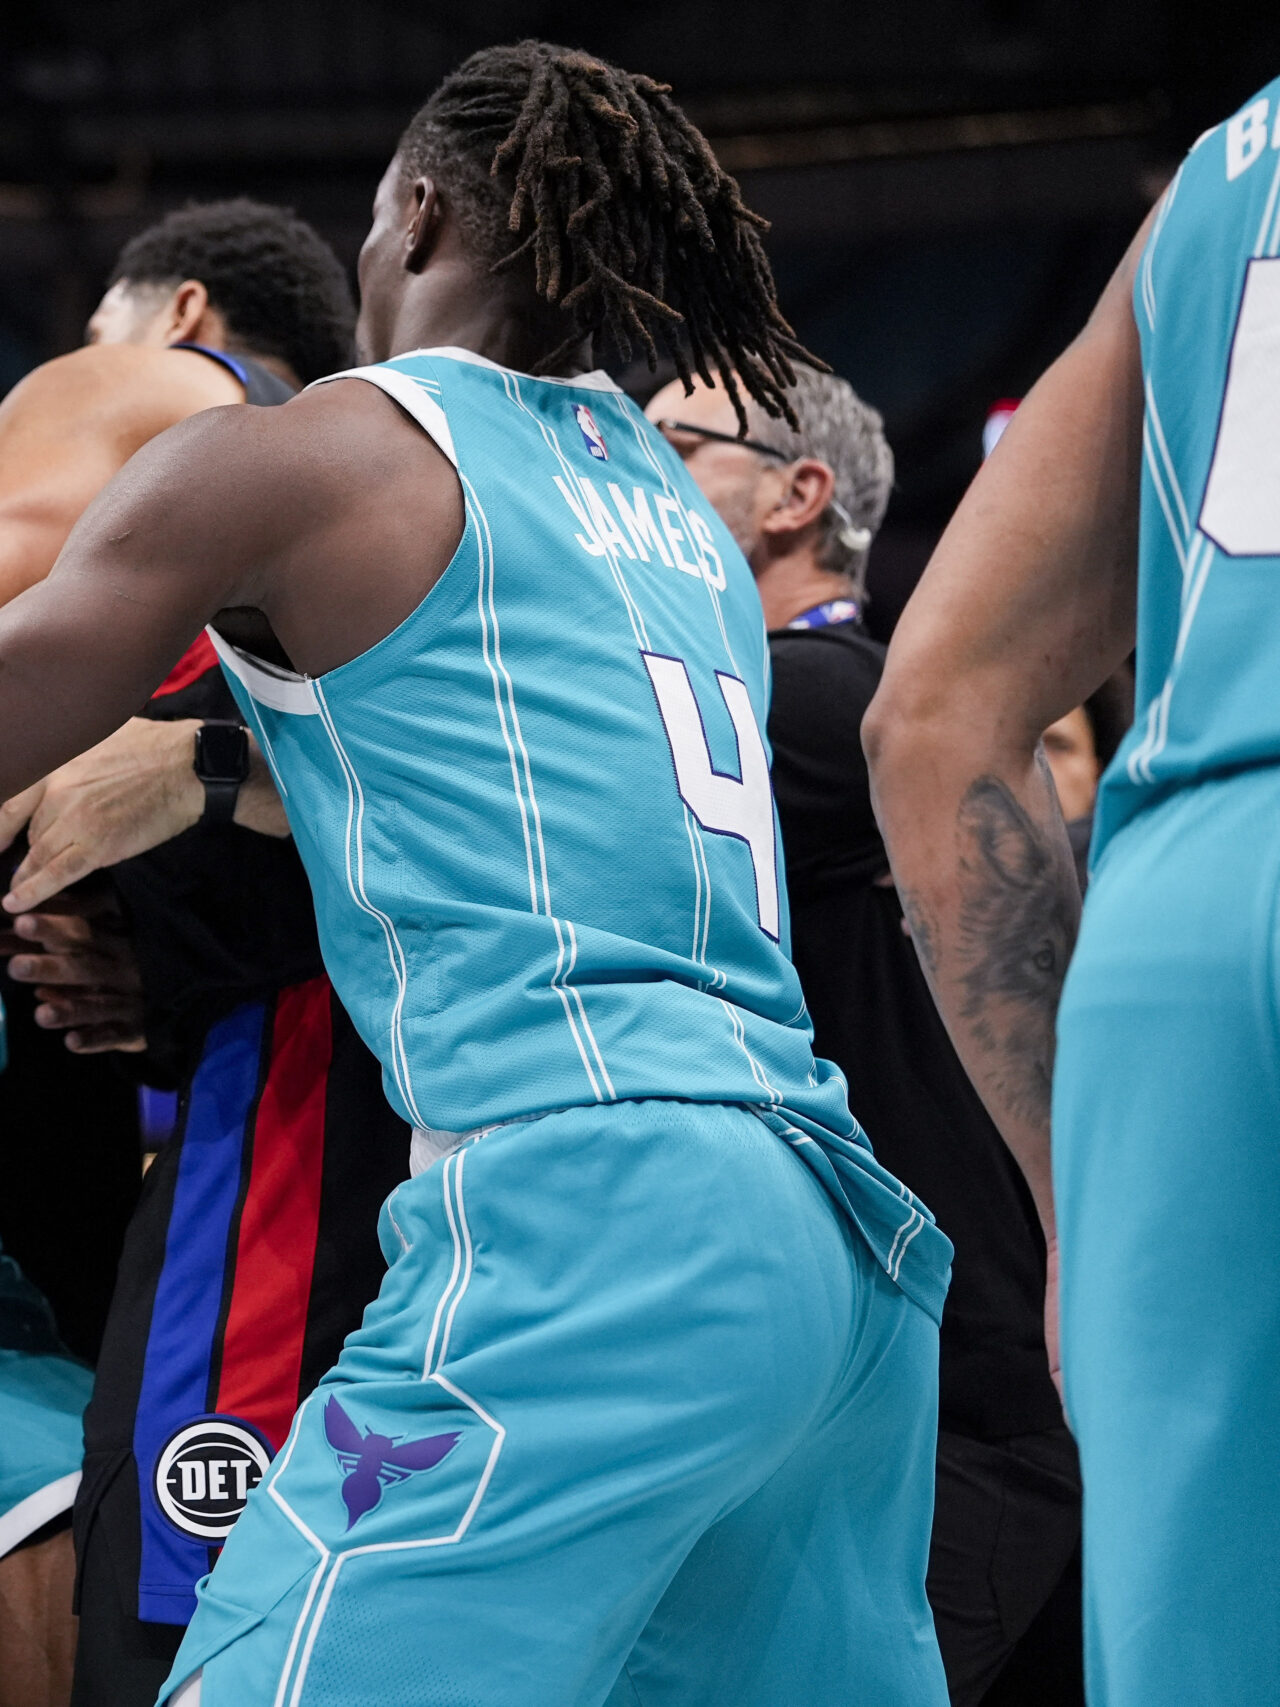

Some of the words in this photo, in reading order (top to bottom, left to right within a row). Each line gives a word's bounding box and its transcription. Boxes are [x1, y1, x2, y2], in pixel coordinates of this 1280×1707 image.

[1226, 96, 1280, 182] B
[551, 475, 727, 592] JAMES
[639, 650, 780, 945] 4
[176, 1460, 252, 1500] DET
